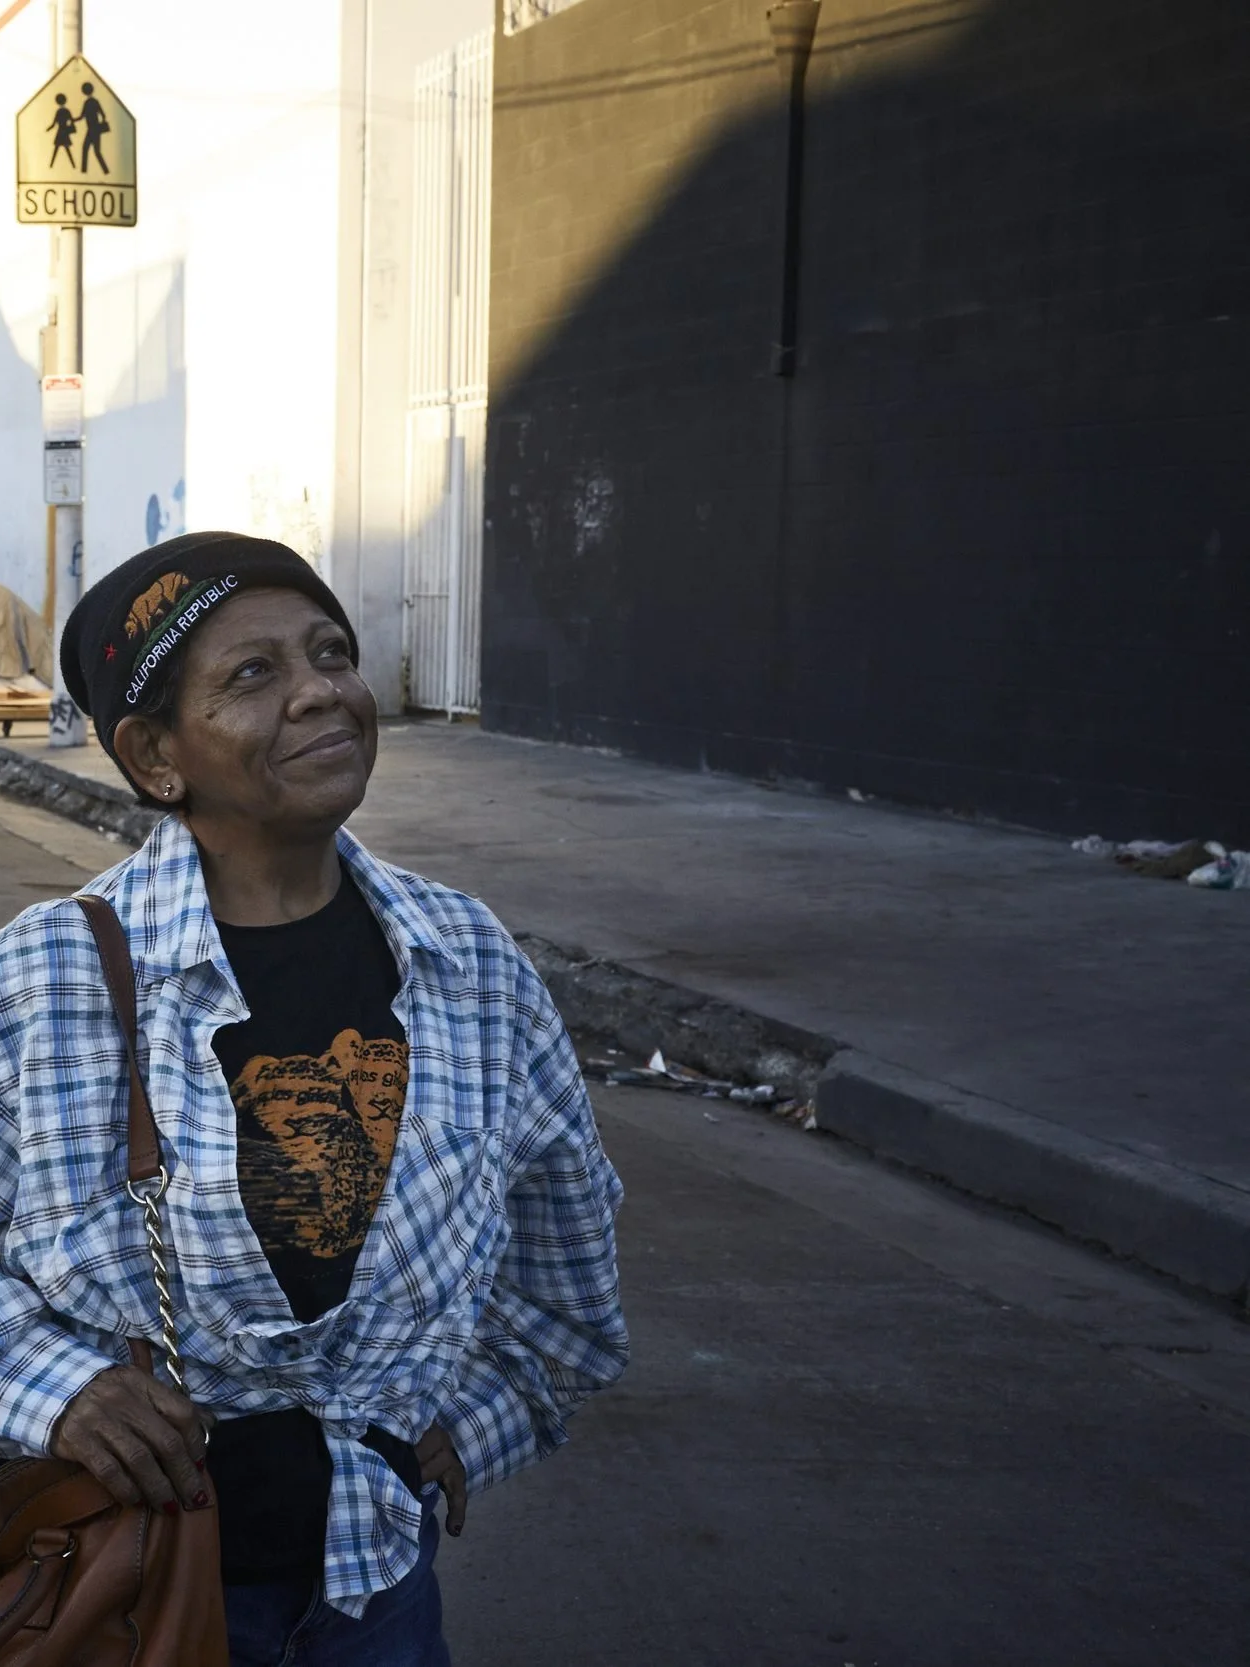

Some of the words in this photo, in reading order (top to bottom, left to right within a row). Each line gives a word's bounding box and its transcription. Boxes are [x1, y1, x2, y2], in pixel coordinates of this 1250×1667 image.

[25, 189, 131, 219] SCHOOL
[126, 627, 182, 703] CALIFORNIA
[176, 574, 238, 632] REPUBLIC
